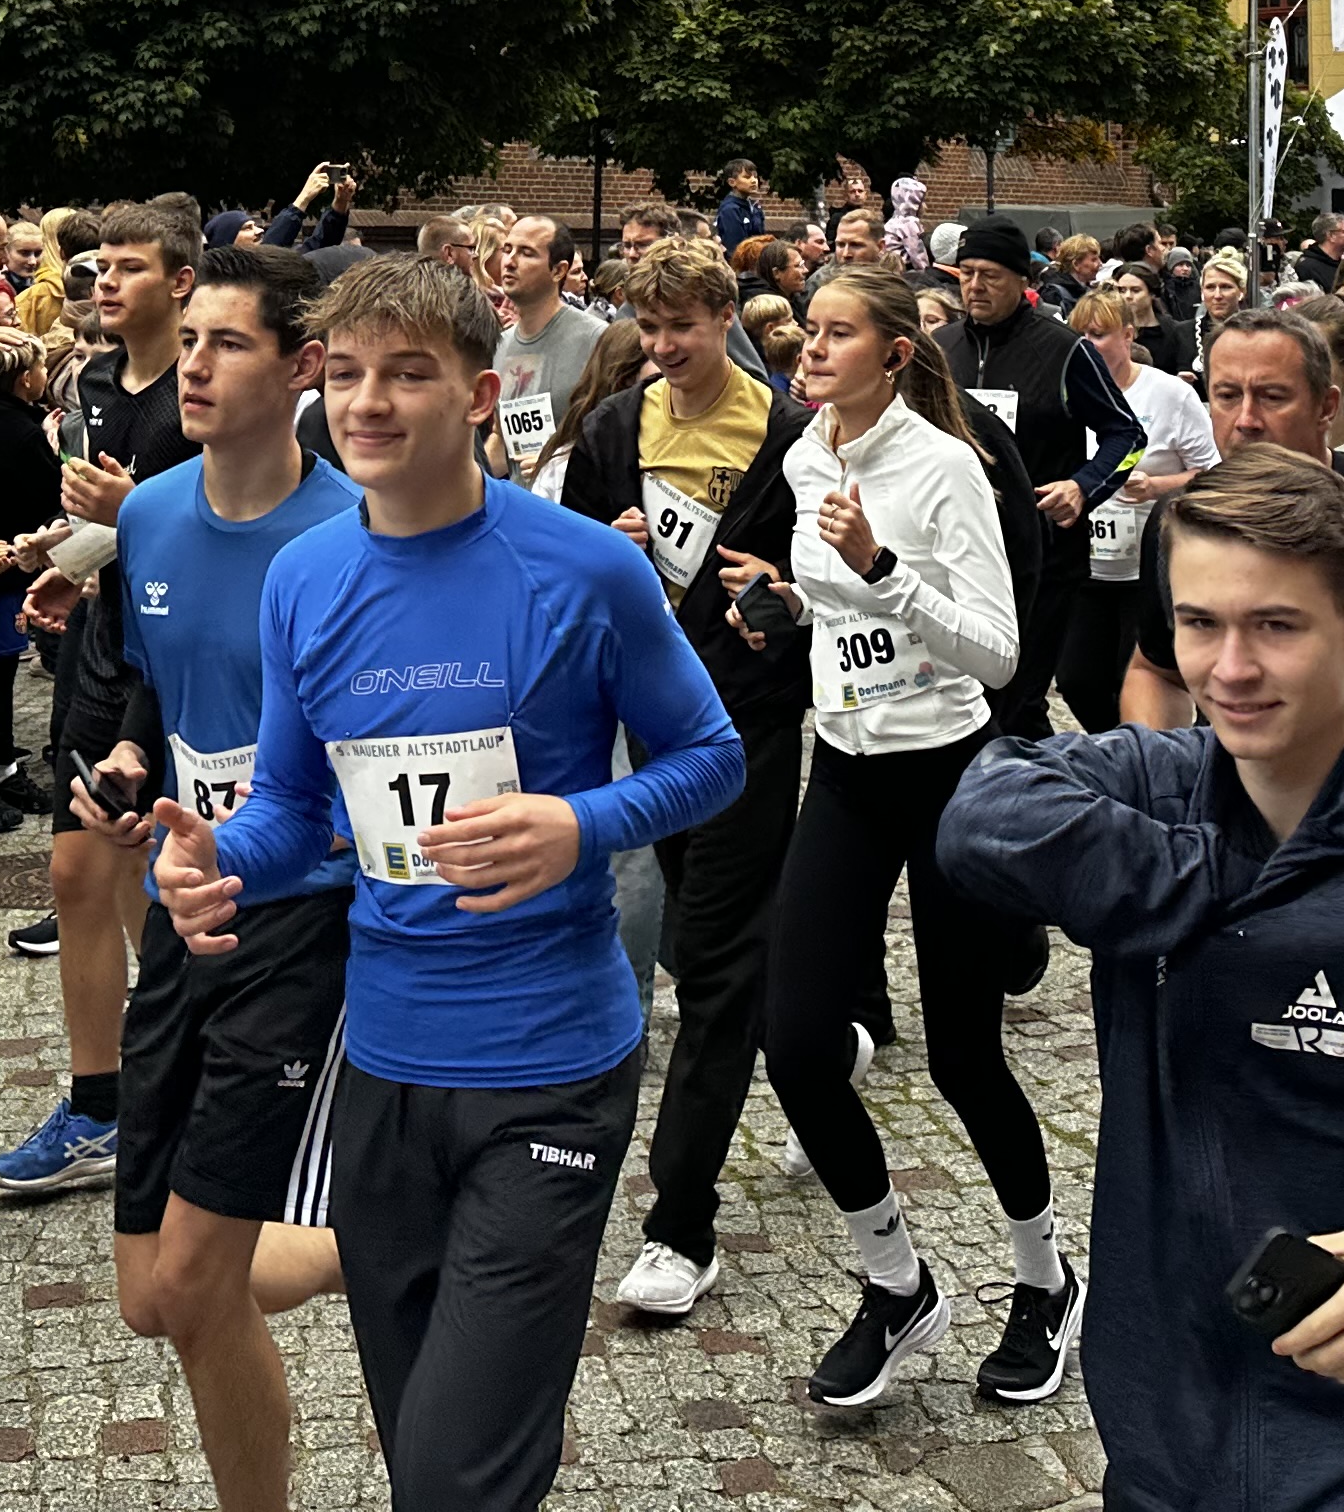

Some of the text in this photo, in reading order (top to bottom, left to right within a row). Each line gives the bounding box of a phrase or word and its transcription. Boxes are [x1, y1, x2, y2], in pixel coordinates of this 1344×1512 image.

[504, 409, 544, 436] 1065
[657, 507, 694, 550] 91
[837, 627, 896, 673] 309
[351, 662, 505, 695] O'NEILL
[858, 678, 907, 697] Dorfmann
[353, 743, 401, 758] NAUENER
[407, 735, 505, 757] ALTSTADTLAUF
[193, 778, 237, 821] 87
[388, 772, 451, 827] 17
[529, 1142, 596, 1171] TIBHAR
